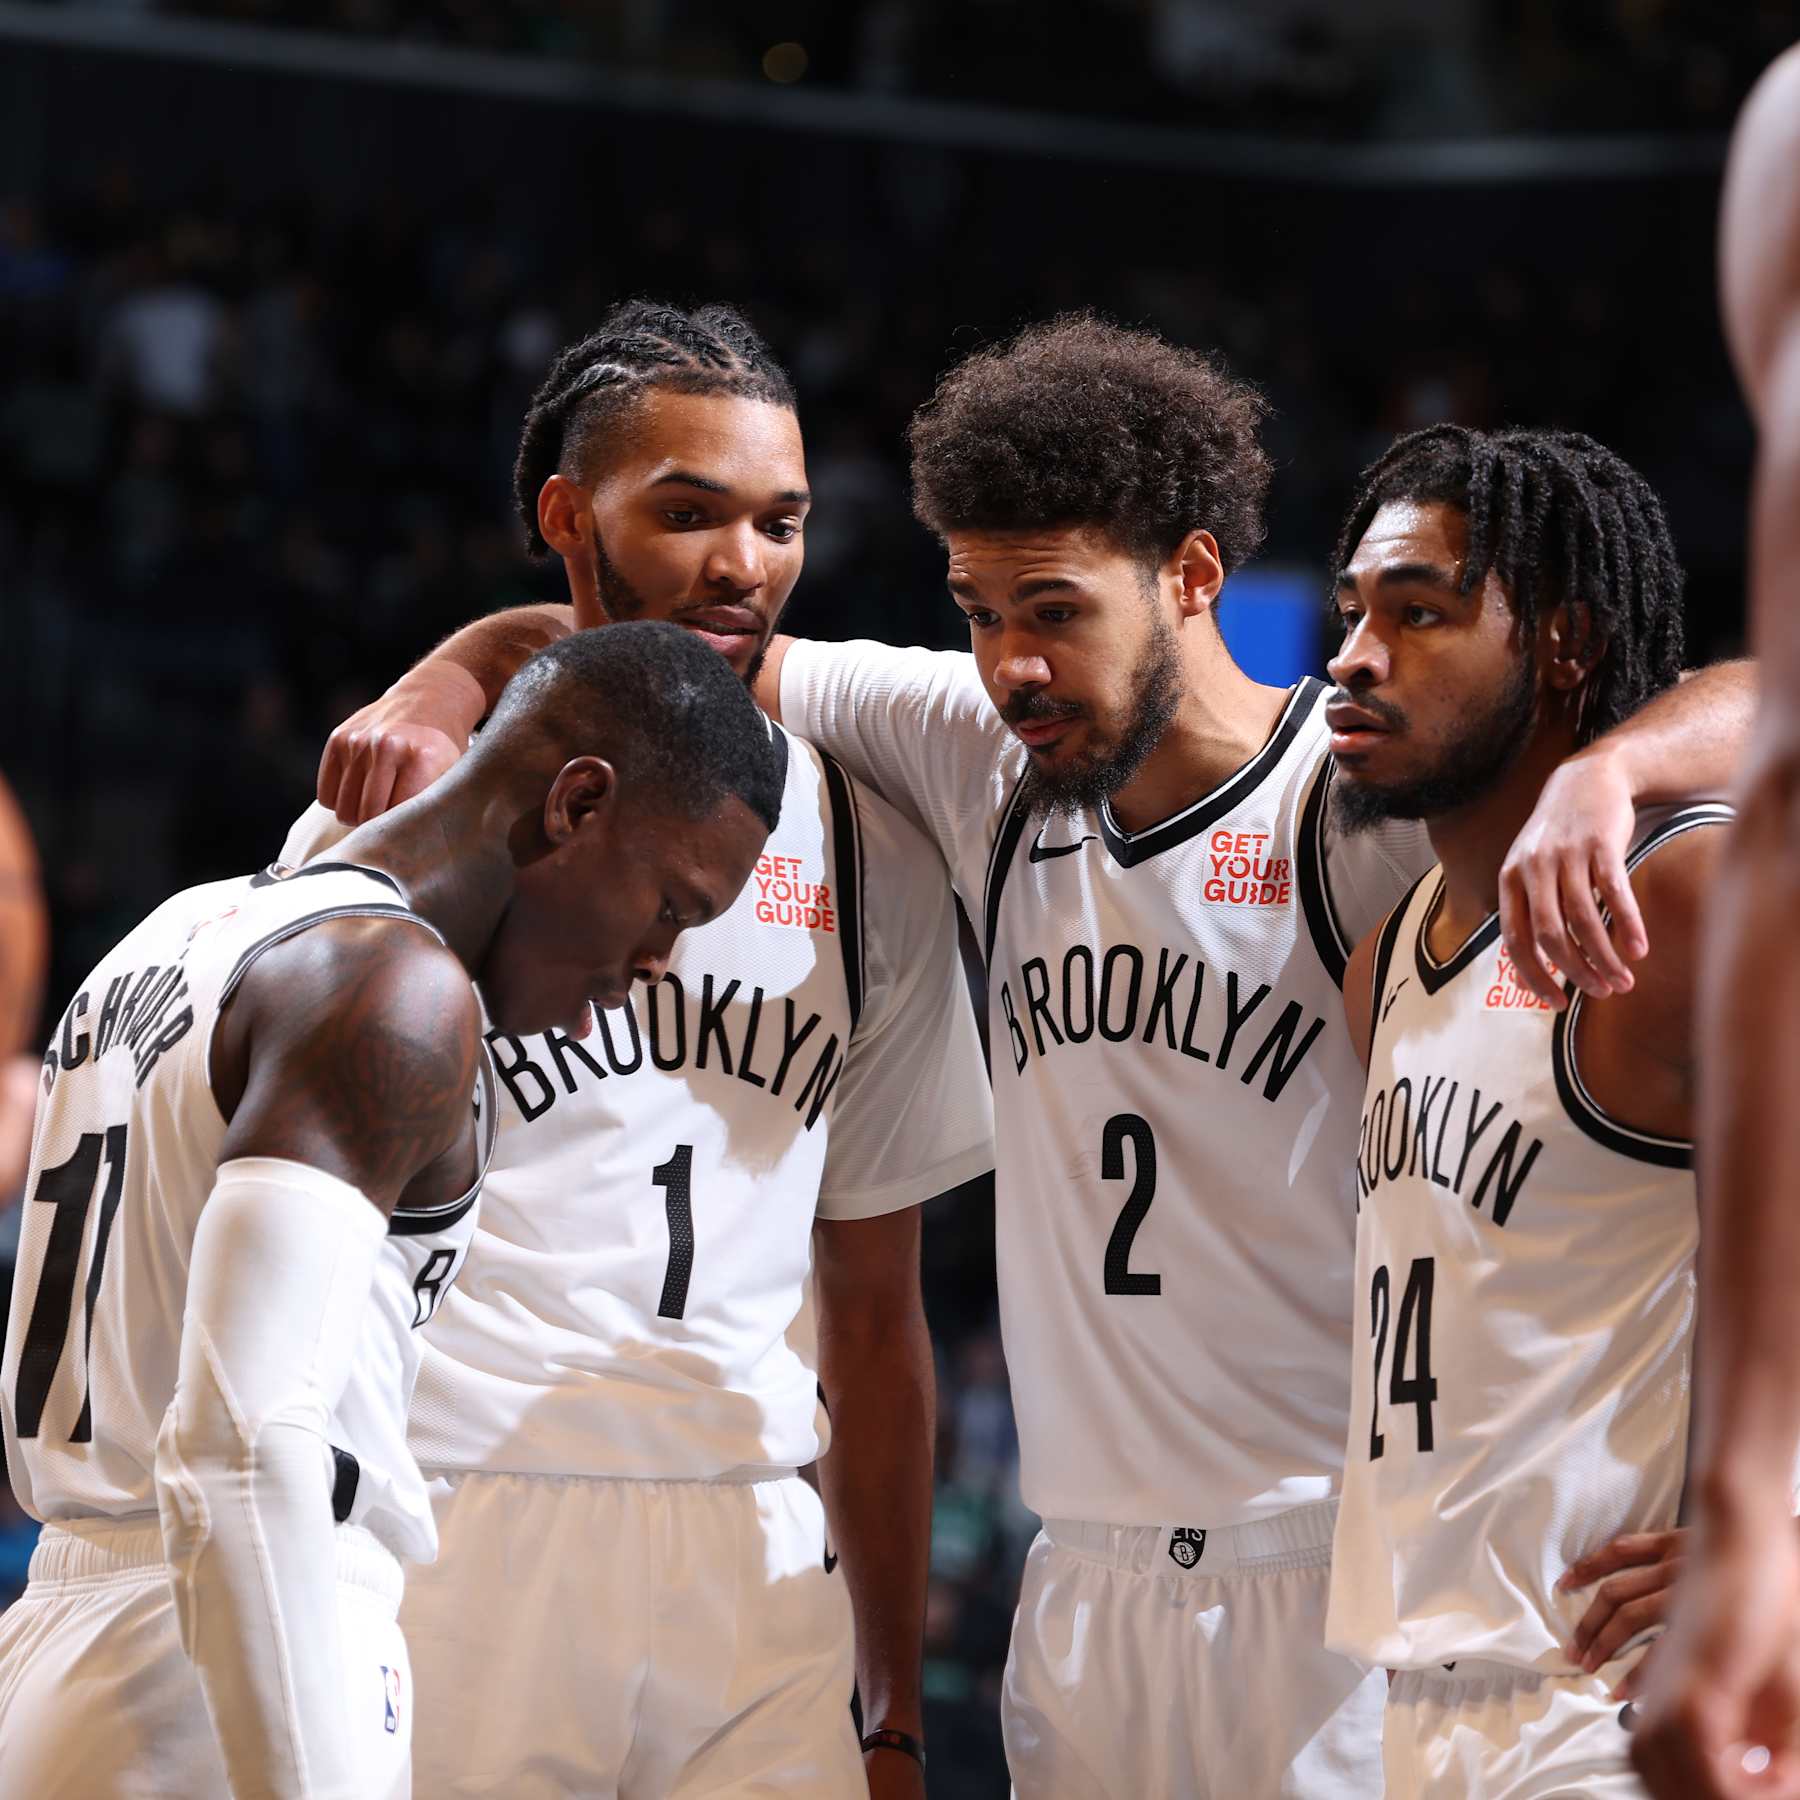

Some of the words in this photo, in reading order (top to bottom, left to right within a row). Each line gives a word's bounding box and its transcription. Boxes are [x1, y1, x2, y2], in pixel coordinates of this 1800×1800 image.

[754, 854, 802, 880] GET
[1210, 854, 1289, 880] YOUR
[1211, 831, 1269, 855] GET
[755, 876, 830, 907] YOUR
[756, 901, 835, 933] GUIDE
[1204, 879, 1292, 905] GUIDE
[1001, 944, 1326, 1102] BROOKLYN
[1356, 1075, 1543, 1227] ROOKLYN
[652, 1144, 695, 1320] 1
[1101, 1113, 1161, 1295] 2
[15, 1124, 128, 1443] 11
[1369, 1256, 1438, 1462] 24
